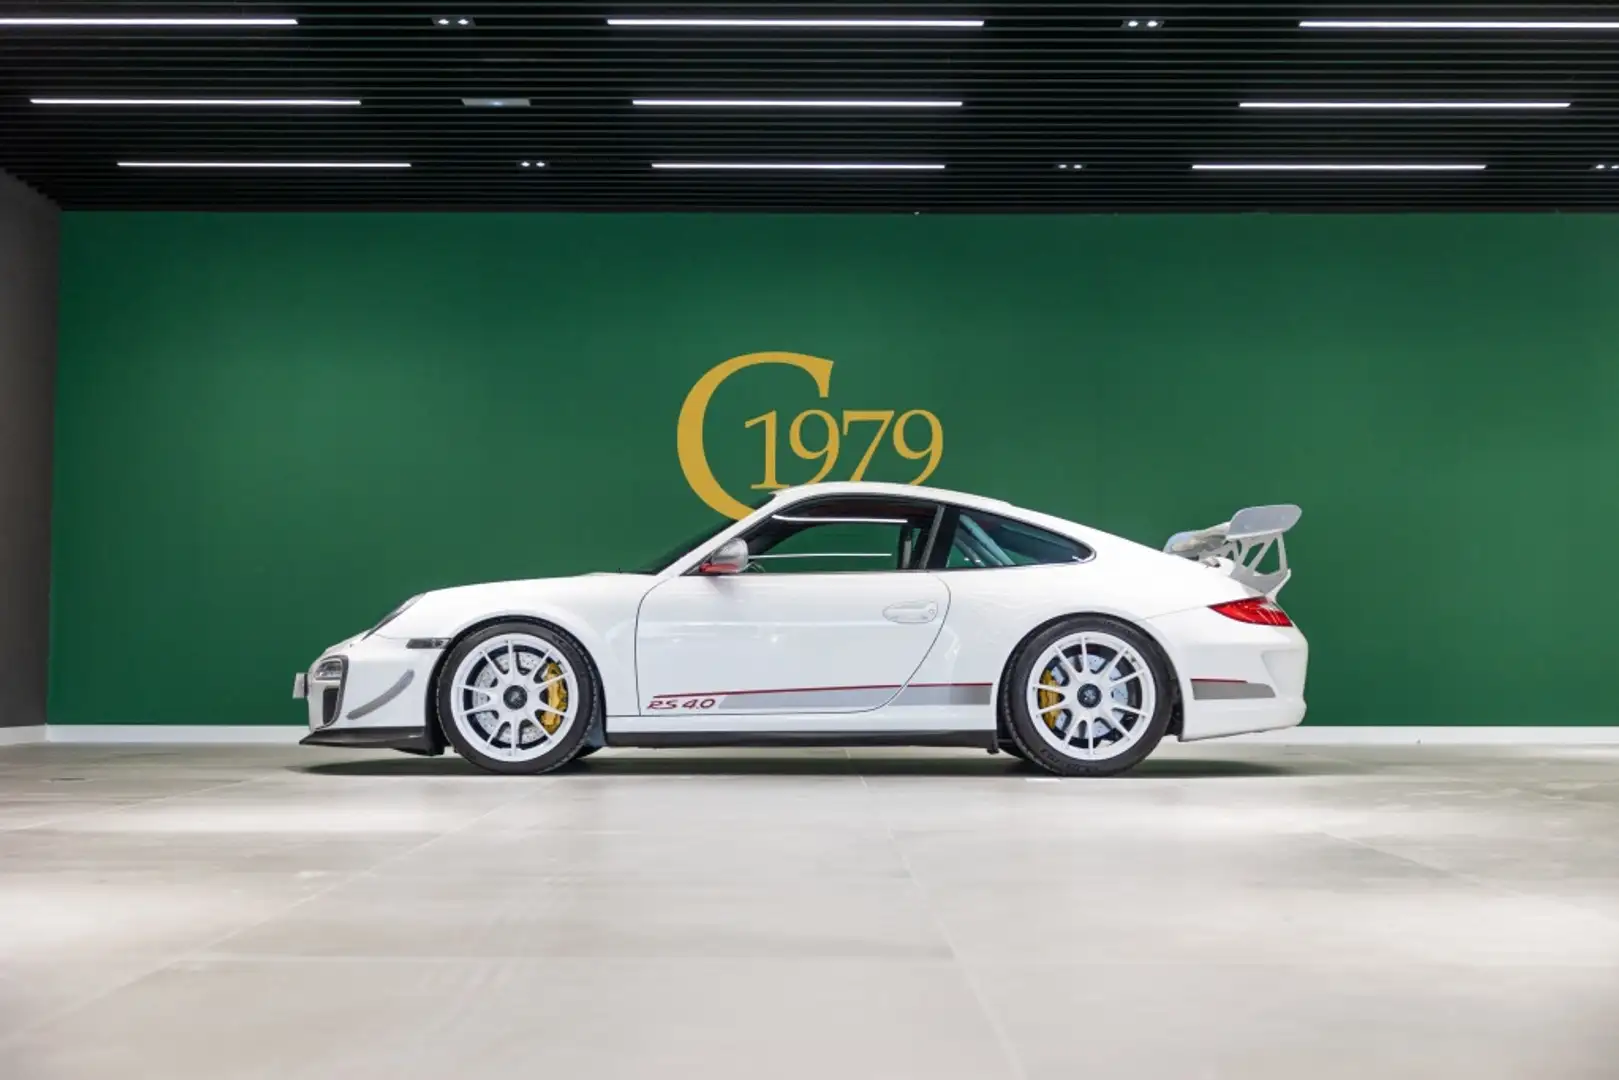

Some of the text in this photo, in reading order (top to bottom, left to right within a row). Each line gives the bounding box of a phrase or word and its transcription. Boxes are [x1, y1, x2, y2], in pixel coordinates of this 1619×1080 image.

[745, 409, 944, 489] 1979
[647, 698, 716, 710] RS 4.0
